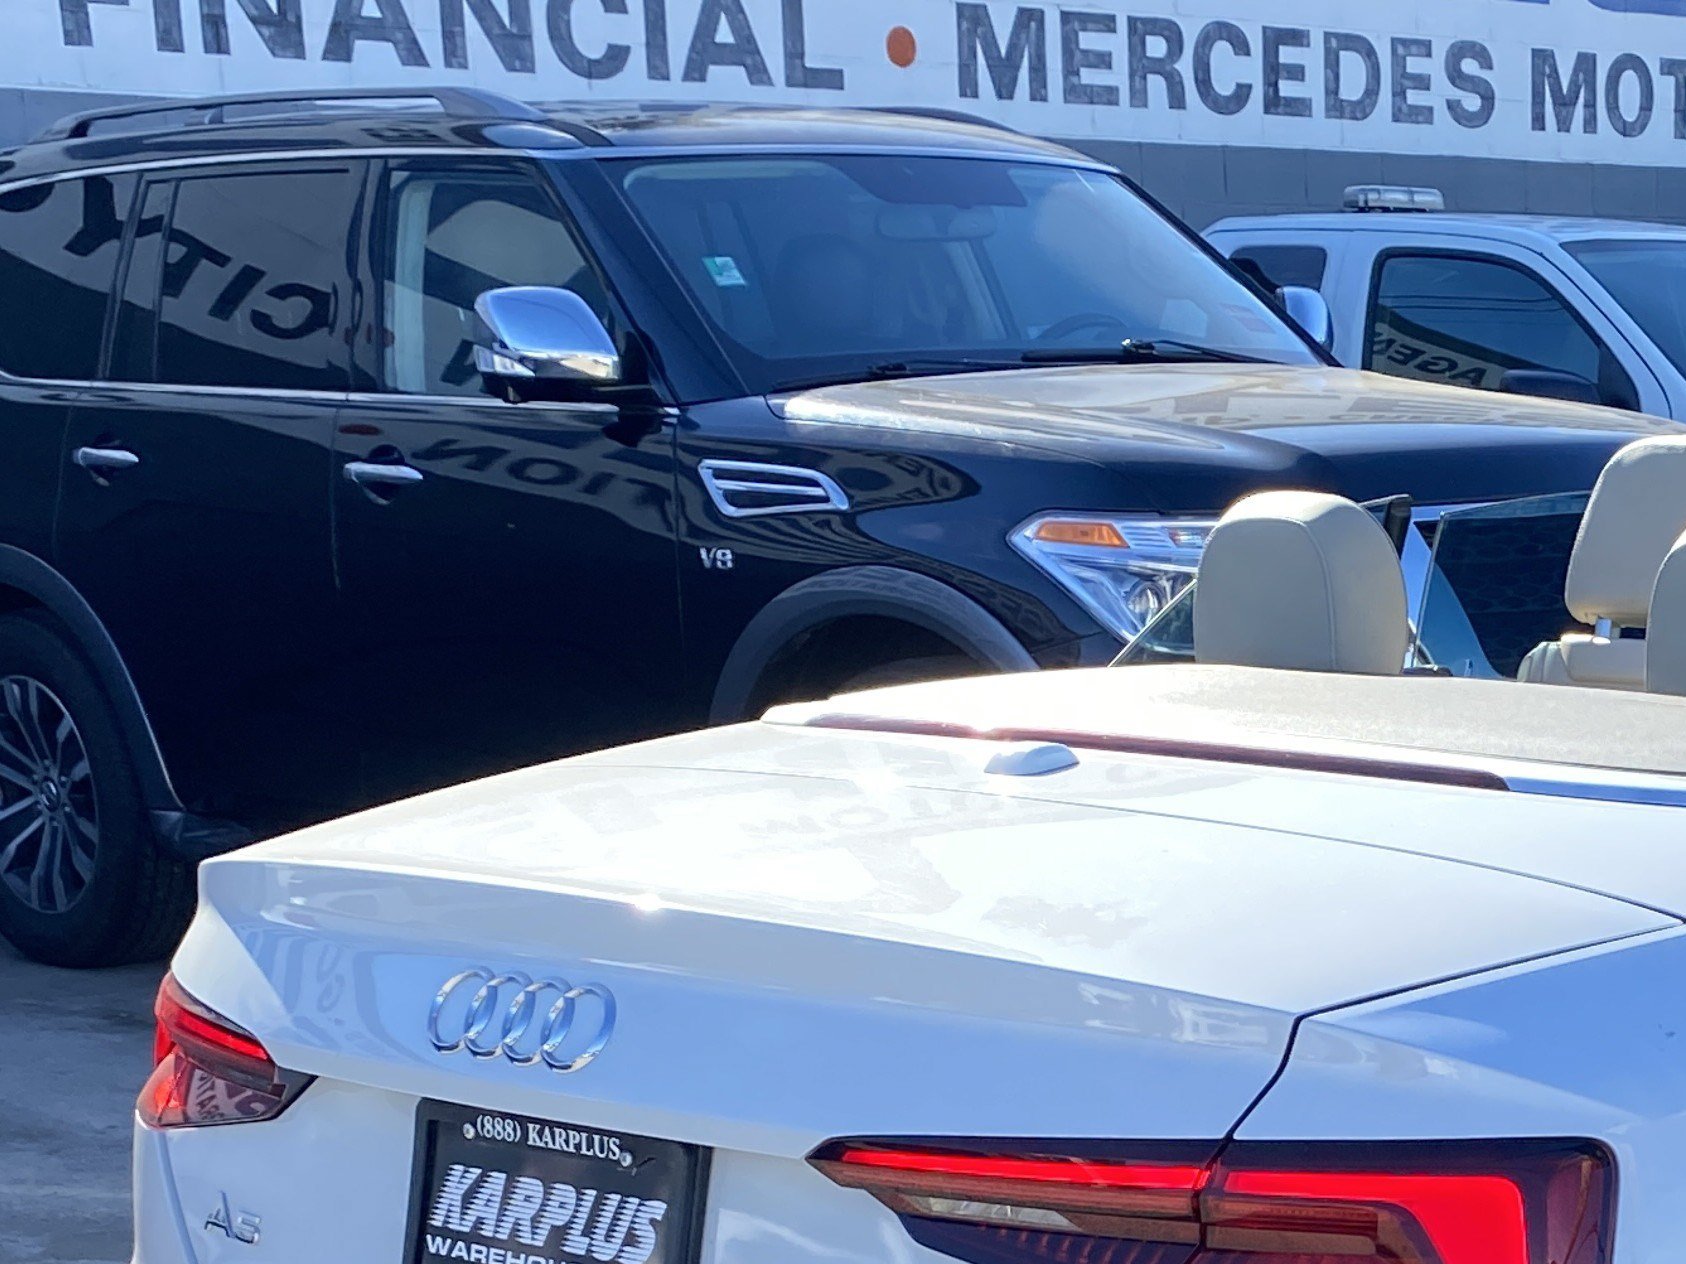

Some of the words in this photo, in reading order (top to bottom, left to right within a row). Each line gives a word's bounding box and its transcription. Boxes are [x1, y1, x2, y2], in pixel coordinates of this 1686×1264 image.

[955, 1, 1495, 130] MERCEDES
[700, 547, 734, 570] V8
[476, 1114, 521, 1143] (888)
[527, 1122, 620, 1161] KARPLUS
